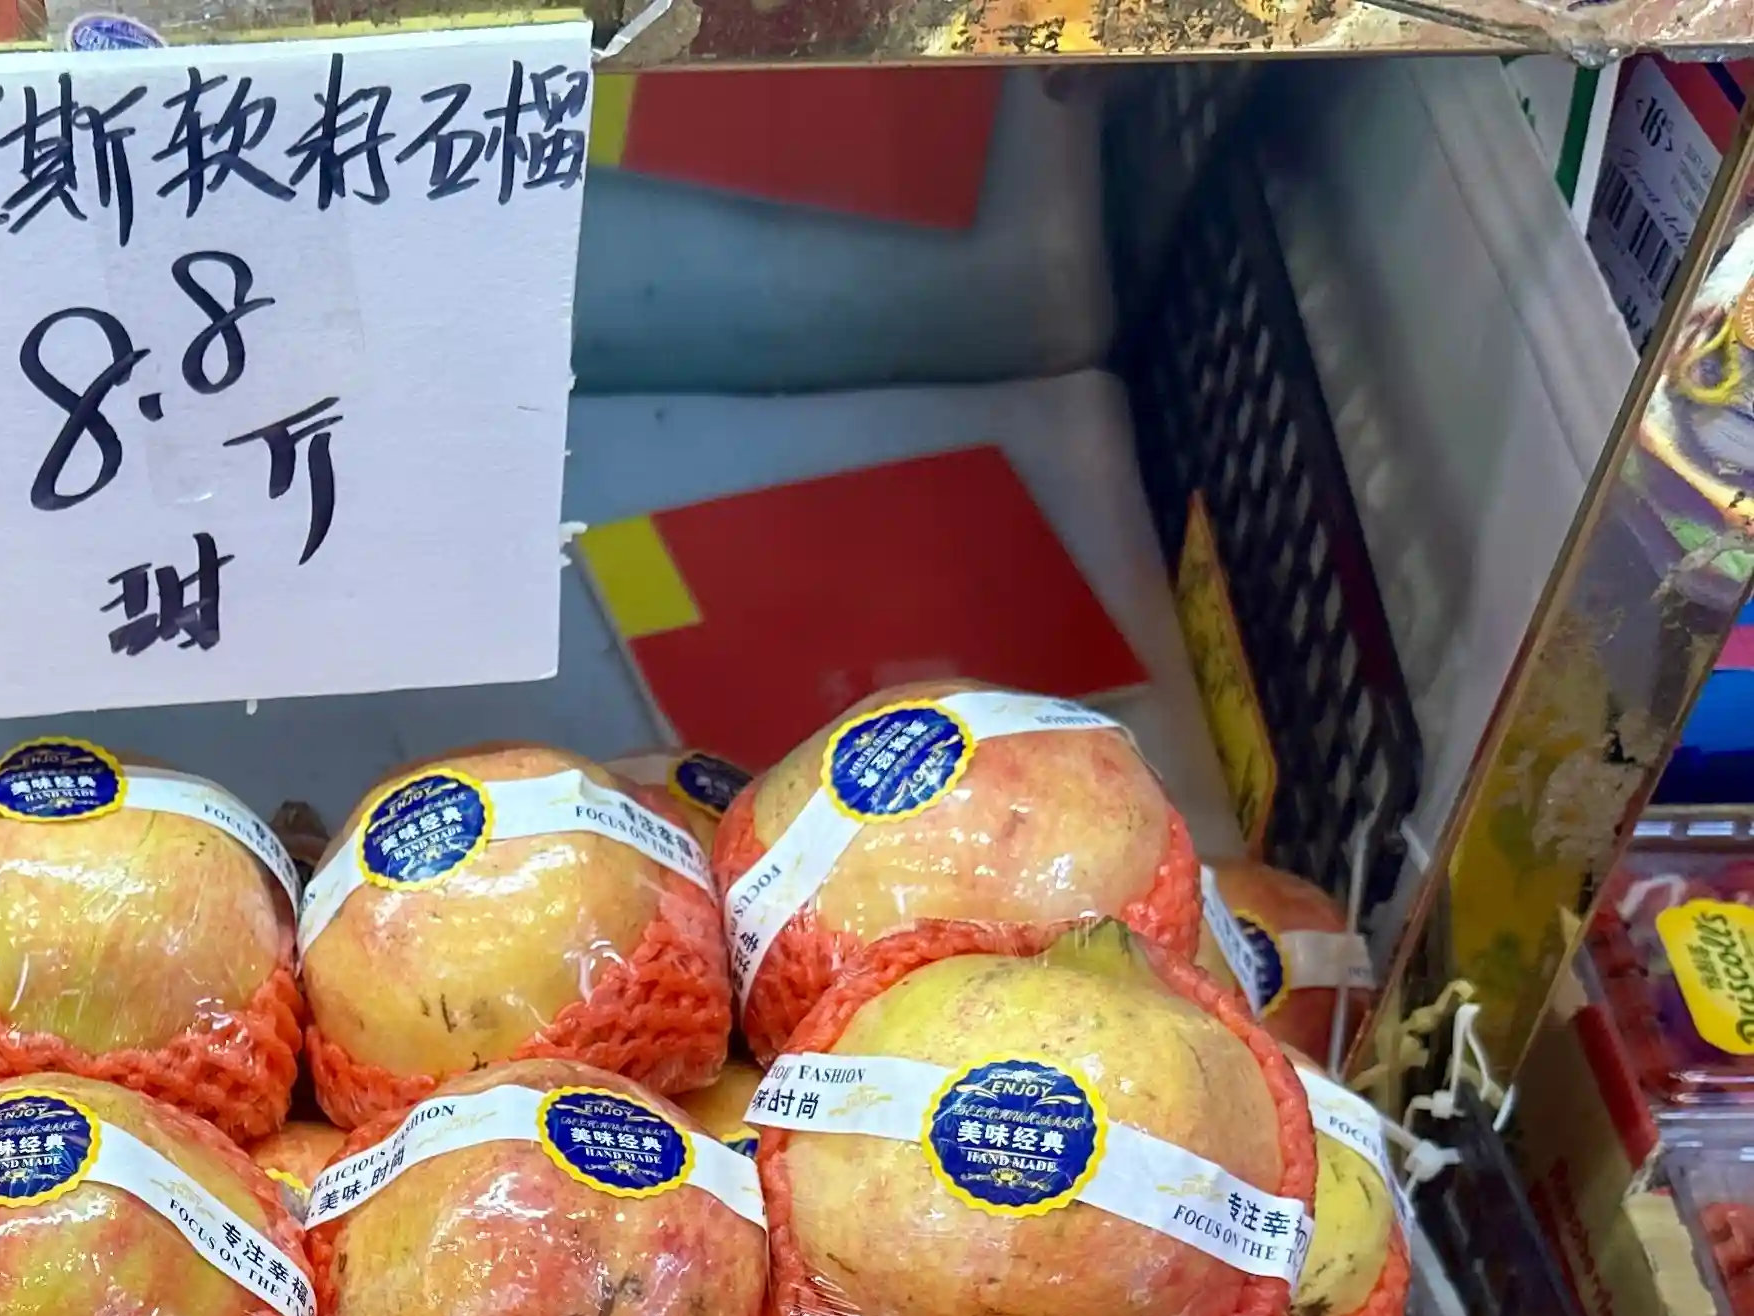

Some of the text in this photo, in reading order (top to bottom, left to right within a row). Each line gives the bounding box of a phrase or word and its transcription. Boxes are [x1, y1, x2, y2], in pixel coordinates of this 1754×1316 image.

[10, 774, 97, 796] 美味经典
[387, 783, 434, 812] ENJOY
[381, 807, 464, 854] 美味经典
[575, 805, 627, 833] FOCUS
[797, 1065, 867, 1084] FASHION
[990, 1079, 1053, 1100] ENJOY
[583, 1102, 634, 1118] ENJOY
[390, 1103, 457, 1151] FASHION
[957, 1119, 1066, 1157] 美味经典
[571, 1128, 662, 1152] 美味经典
[22, 1155, 62, 1169] MADE
[584, 1147, 662, 1165] HAND MADE
[966, 1151, 1060, 1175] HAND MADE
[1172, 1203, 1279, 1262] FOCUS ON THE
[169, 1197, 280, 1298] FOCUS ON THE
